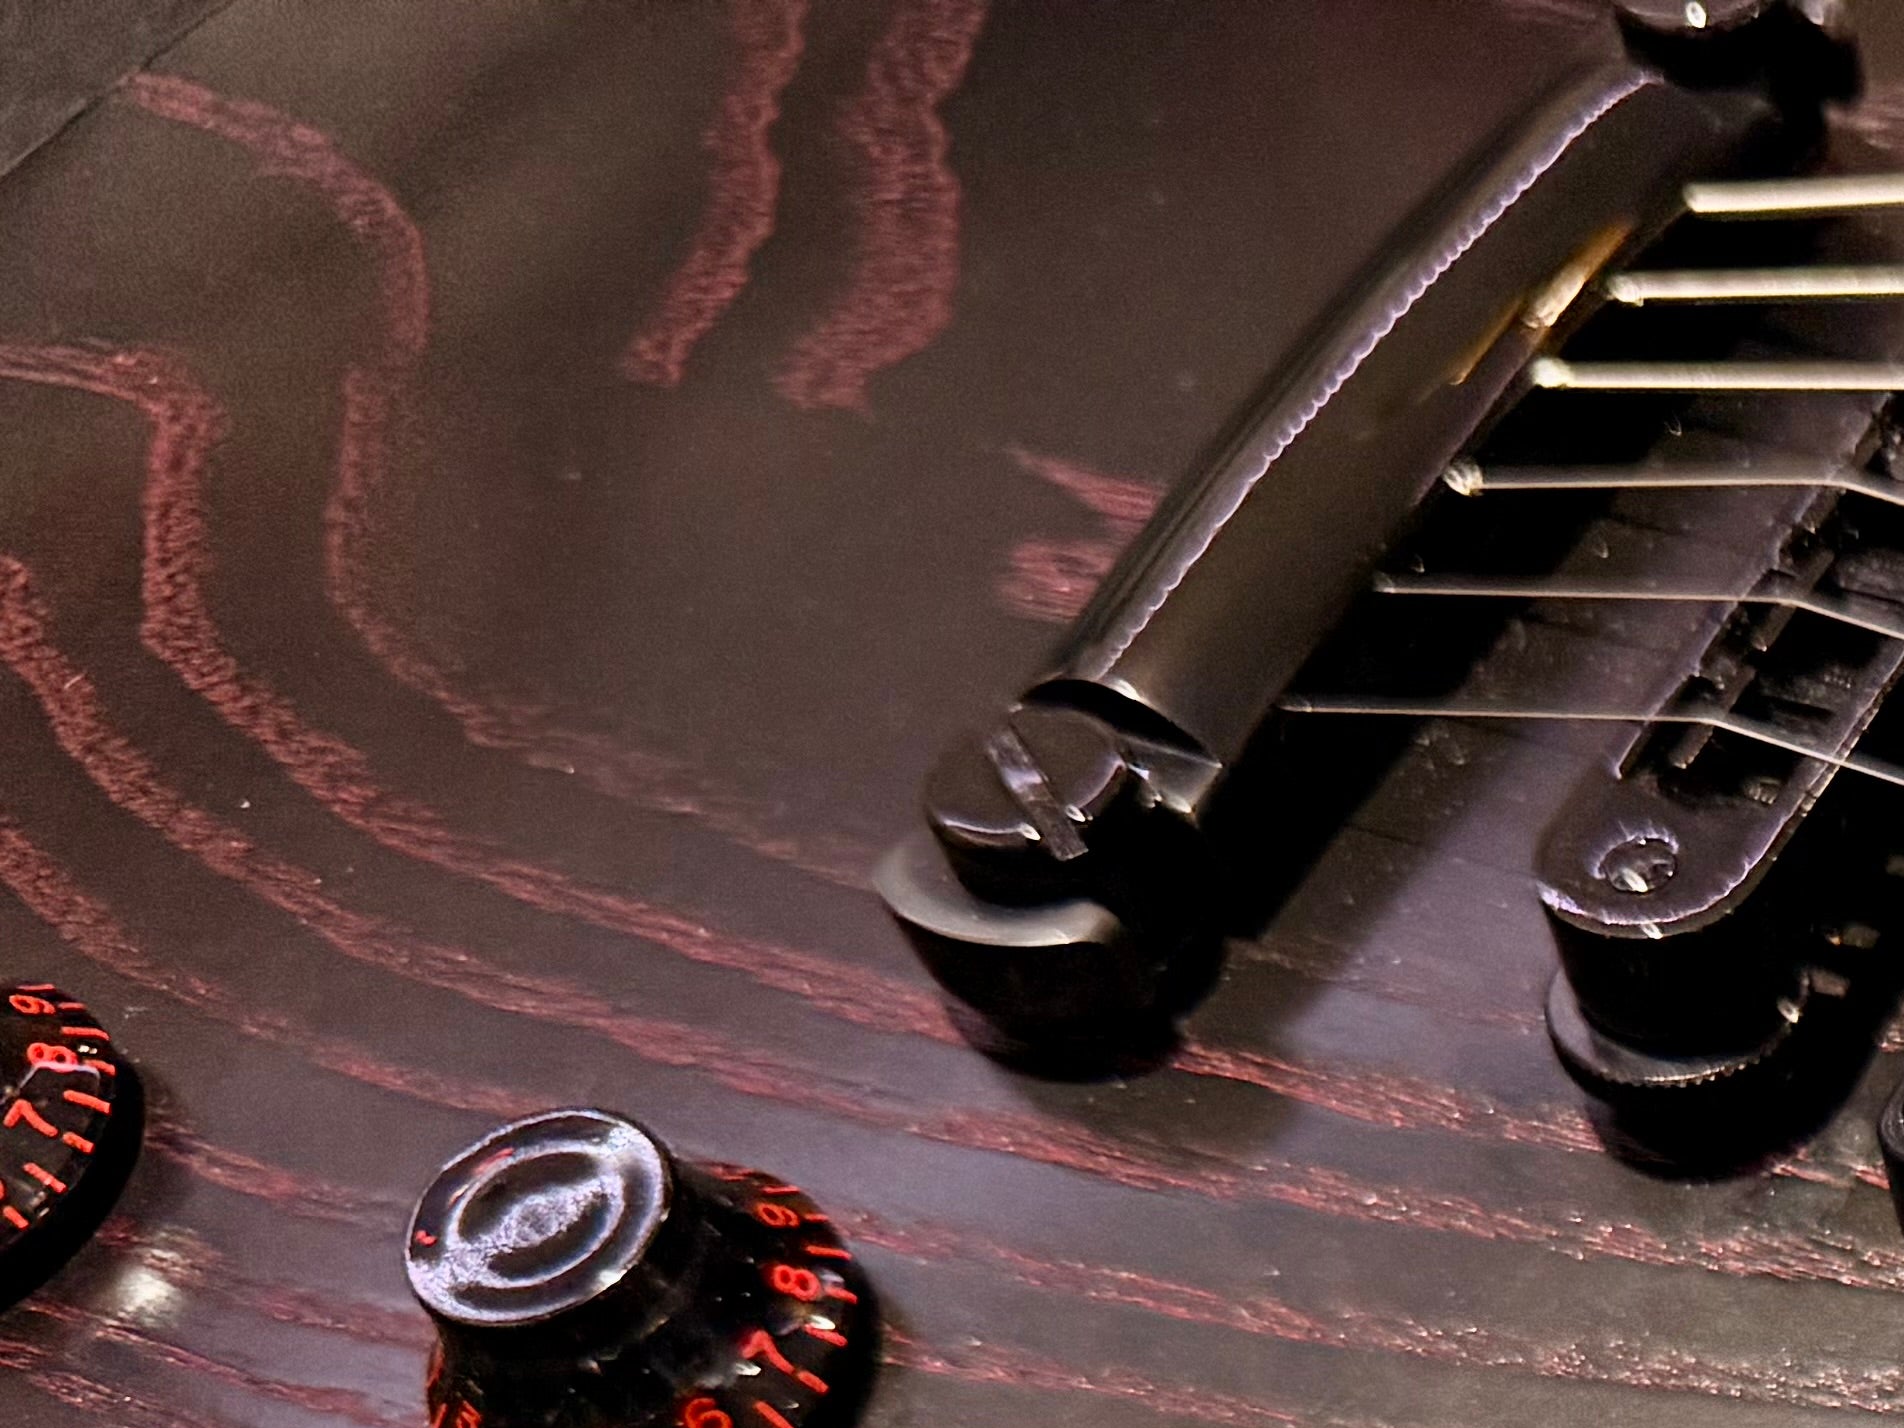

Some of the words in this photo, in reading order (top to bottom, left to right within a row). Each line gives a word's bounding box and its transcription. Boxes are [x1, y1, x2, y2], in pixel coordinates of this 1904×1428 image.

[27, 1042, 79, 1073] 8
[3, 1098, 58, 1137] 7
[757, 1202, 800, 1228] 9
[774, 1265, 821, 1301] 8
[741, 1330, 797, 1375] 7
